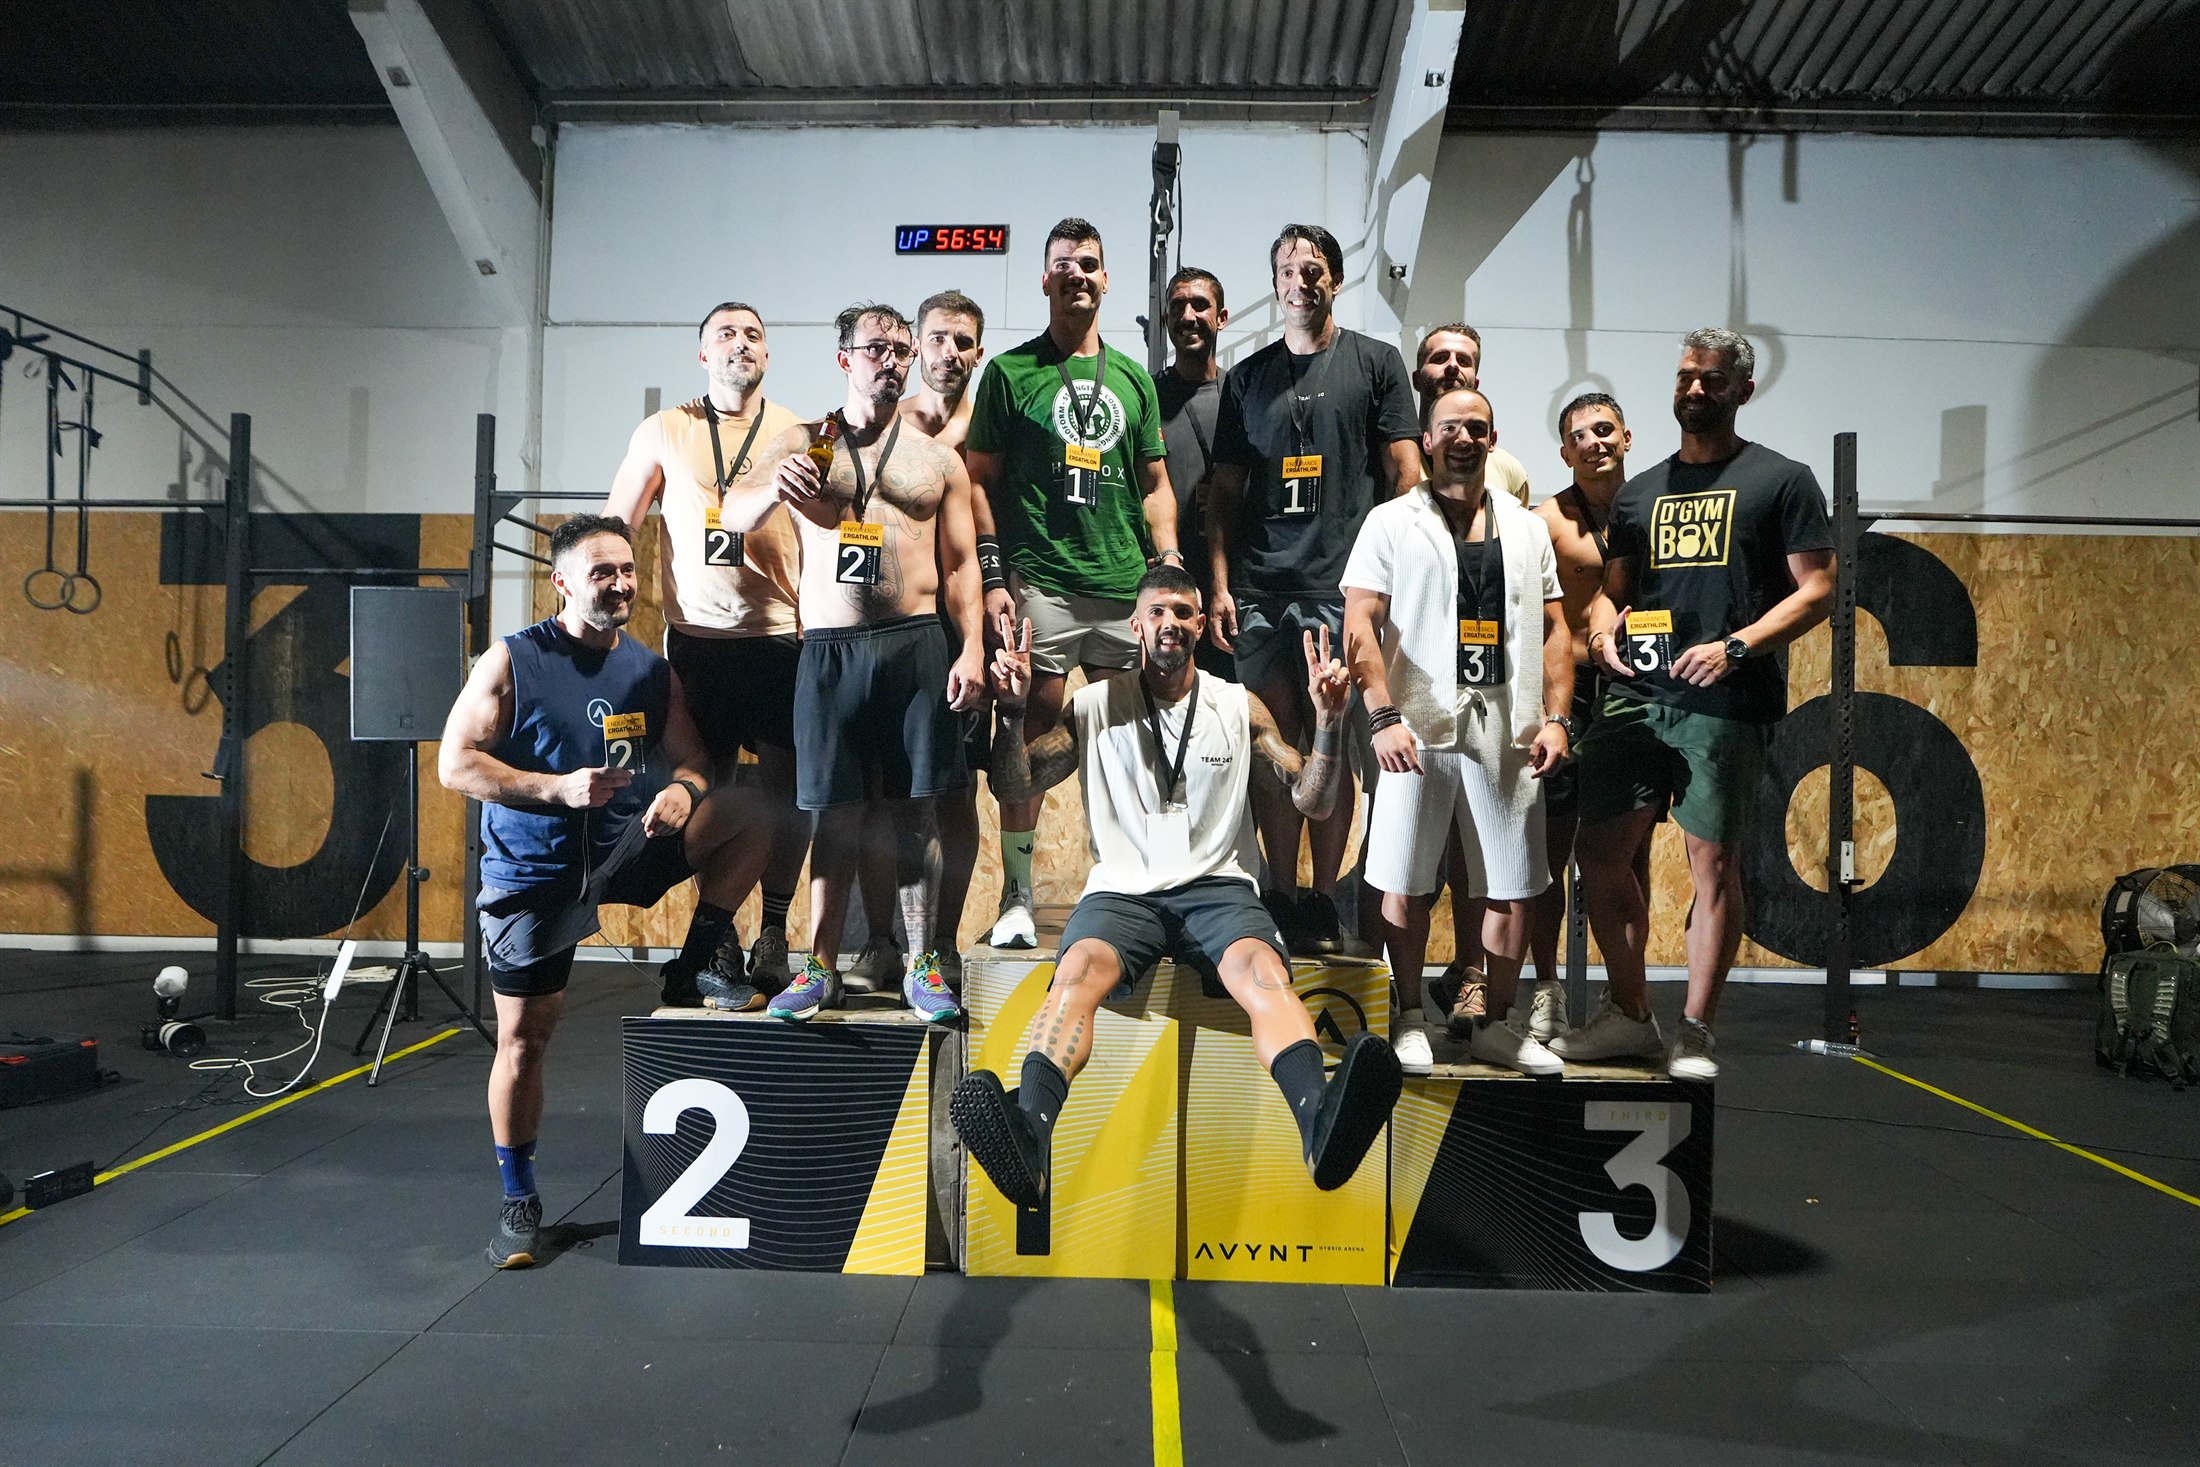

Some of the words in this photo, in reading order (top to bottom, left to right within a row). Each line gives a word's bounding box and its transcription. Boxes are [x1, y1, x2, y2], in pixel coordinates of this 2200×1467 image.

[898, 230, 929, 249] UP
[935, 229, 1003, 250] 56:54
[1058, 406, 1079, 443] PROFORM
[1101, 394, 1120, 447] CONDITIONING
[1052, 462, 1125, 480] HOX
[1069, 455, 1097, 465] ERGATHLON
[1286, 466, 1318, 474] ERGATHLON
[1067, 467, 1086, 504] 1
[1283, 478, 1305, 513] 1
[1660, 497, 1725, 524] D'GYM
[843, 533, 879, 541] ERGATHLON
[844, 526, 879, 535] ENDURANCE
[708, 530, 731, 565] 2
[840, 545, 866, 583] 2
[1463, 645, 1485, 683] 3
[1632, 634, 1659, 672] 3
[145, 513, 420, 938] 3
[608, 725, 643, 734] ERGATHLON
[610, 740, 636, 775] 2
[1610, 1111, 1666, 1121] THIRD
[639, 1078, 750, 1249] 2
[1578, 1101, 1692, 1272] 3
[659, 1225, 731, 1237] SECOND
[1195, 1242, 1313, 1262] AVYNT
